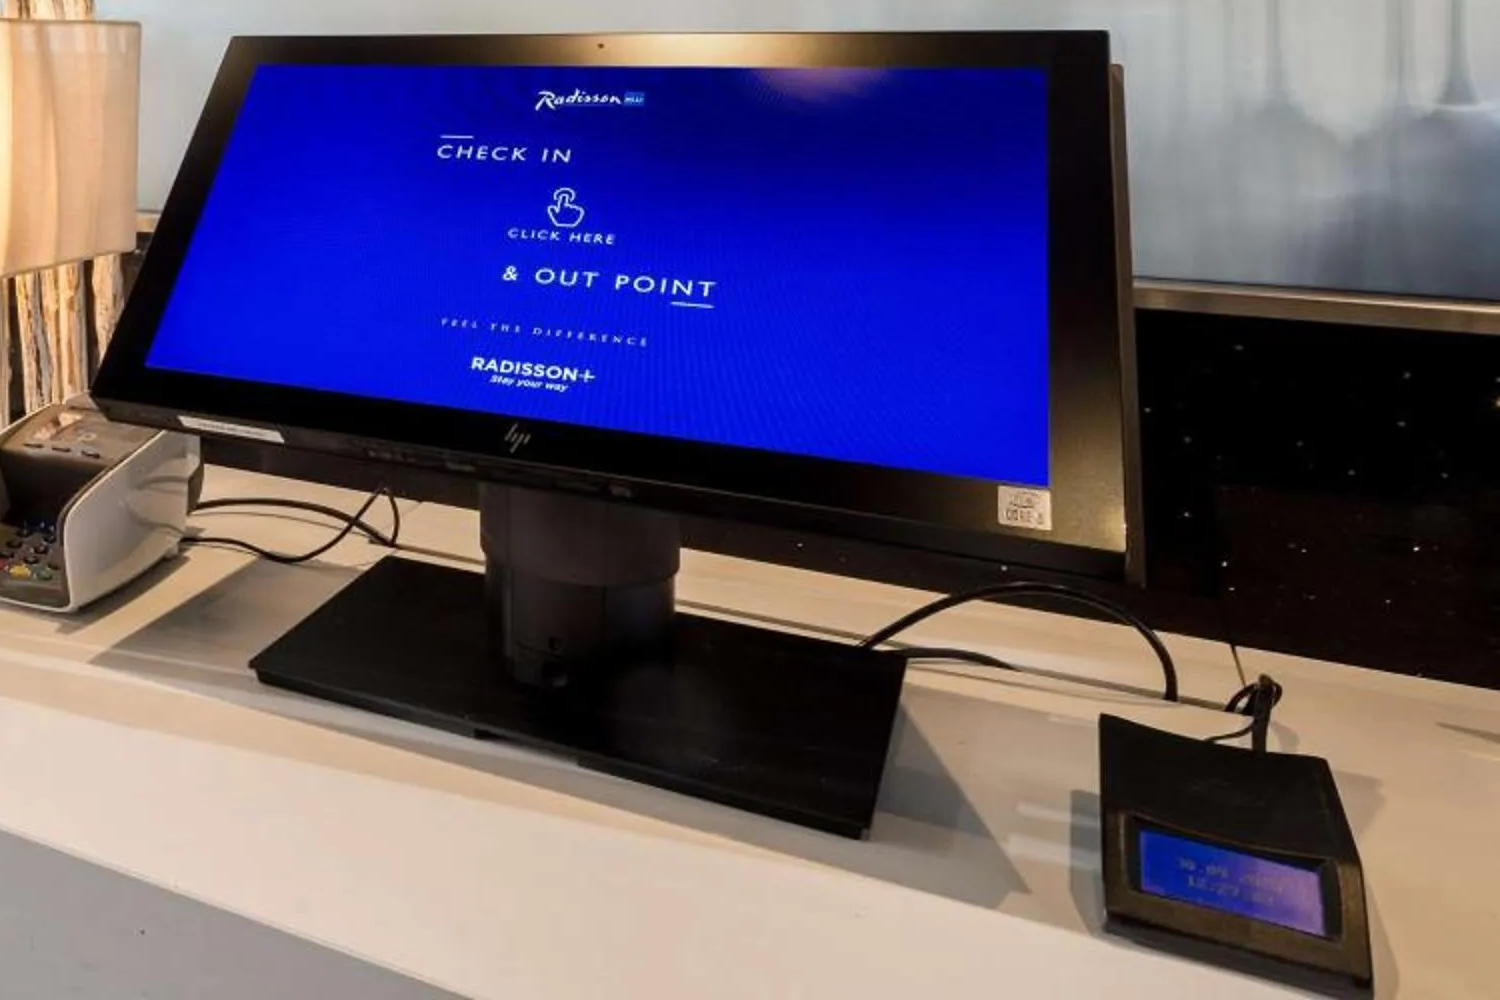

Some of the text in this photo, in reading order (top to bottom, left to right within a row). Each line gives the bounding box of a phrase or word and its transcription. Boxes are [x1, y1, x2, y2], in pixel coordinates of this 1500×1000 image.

[534, 88, 622, 111] Radisson
[436, 144, 572, 163] CHECK IN
[507, 227, 616, 245] CLICK HERE
[501, 265, 717, 298] & OUT POINT
[441, 317, 648, 348] FEEL THE DIFFERENCE
[489, 374, 569, 393] Stay your way
